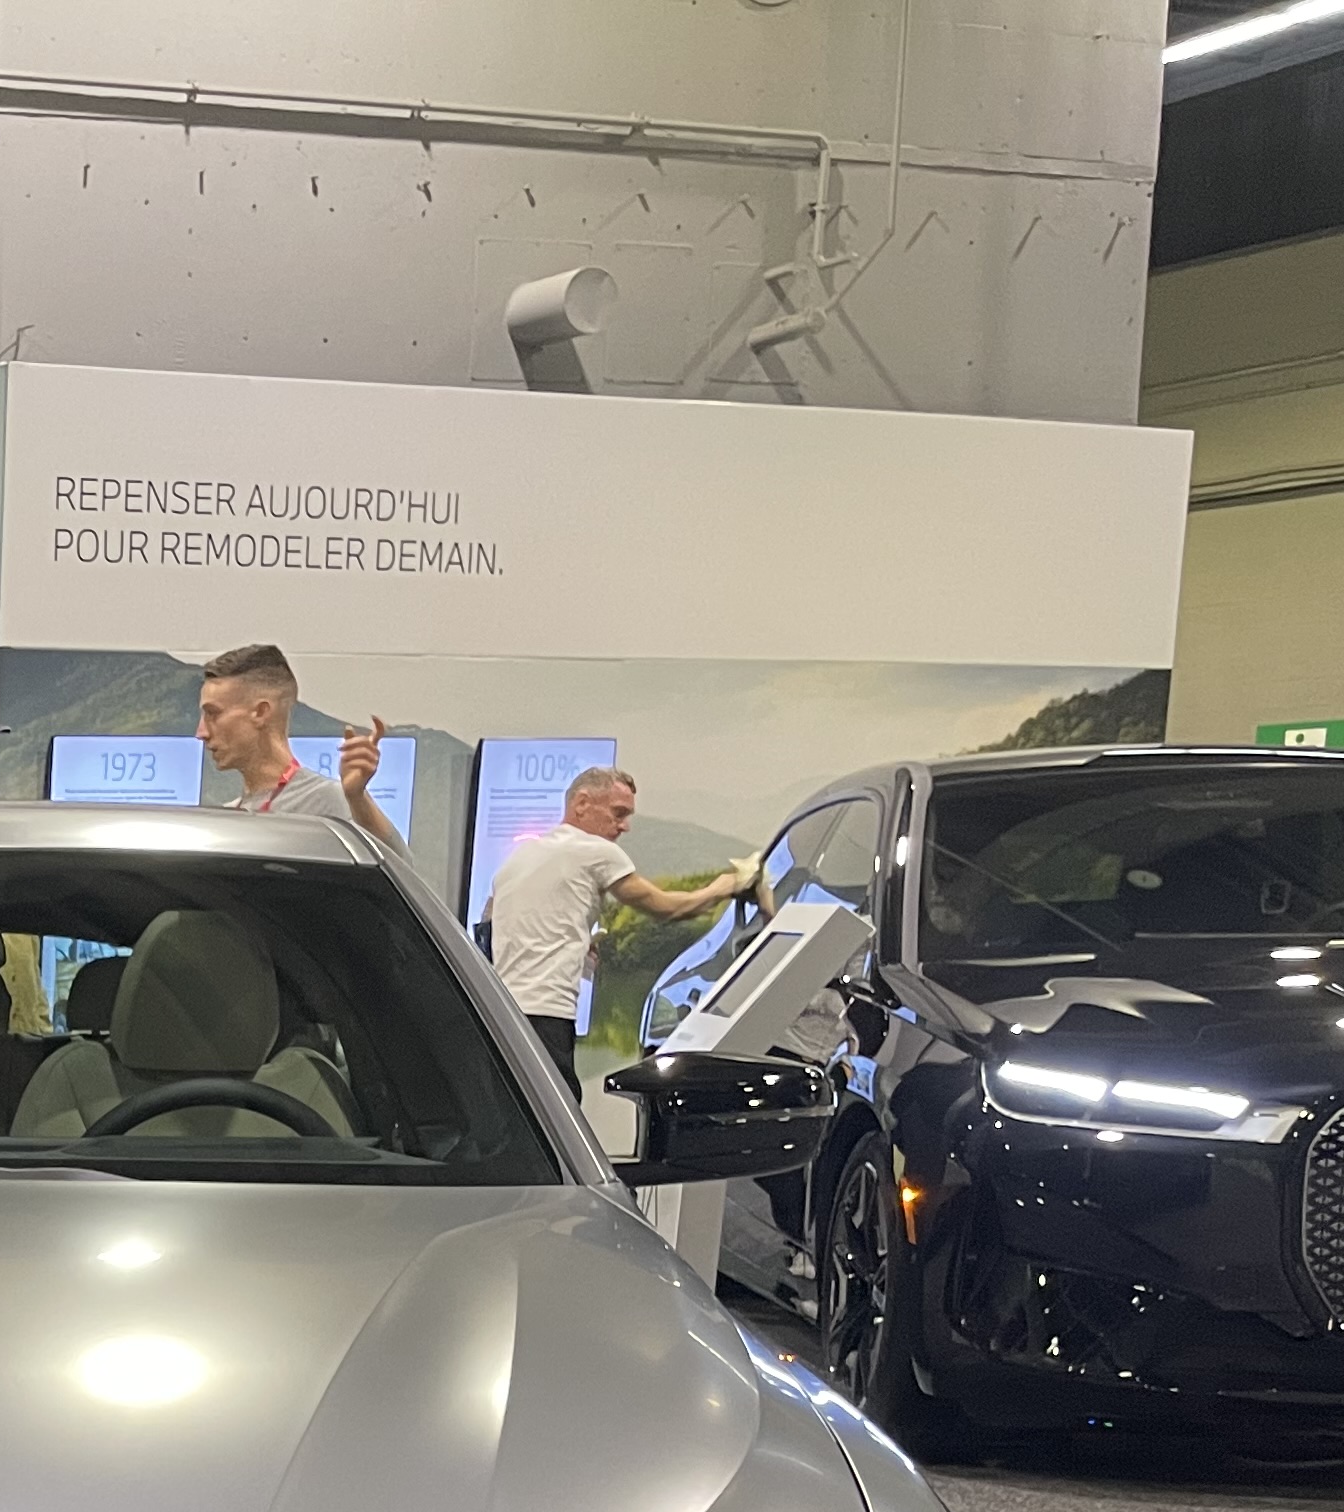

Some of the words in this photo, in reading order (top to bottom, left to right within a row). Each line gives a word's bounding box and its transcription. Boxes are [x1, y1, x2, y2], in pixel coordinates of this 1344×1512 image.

[55, 476, 236, 517] REPENSER
[245, 483, 460, 525] AUJOURD'HUI
[53, 528, 149, 564] POUR
[161, 531, 365, 571] REMODELER
[375, 539, 504, 576] DEMAIN.
[101, 752, 156, 782] 1973
[516, 753, 580, 782] 100%
